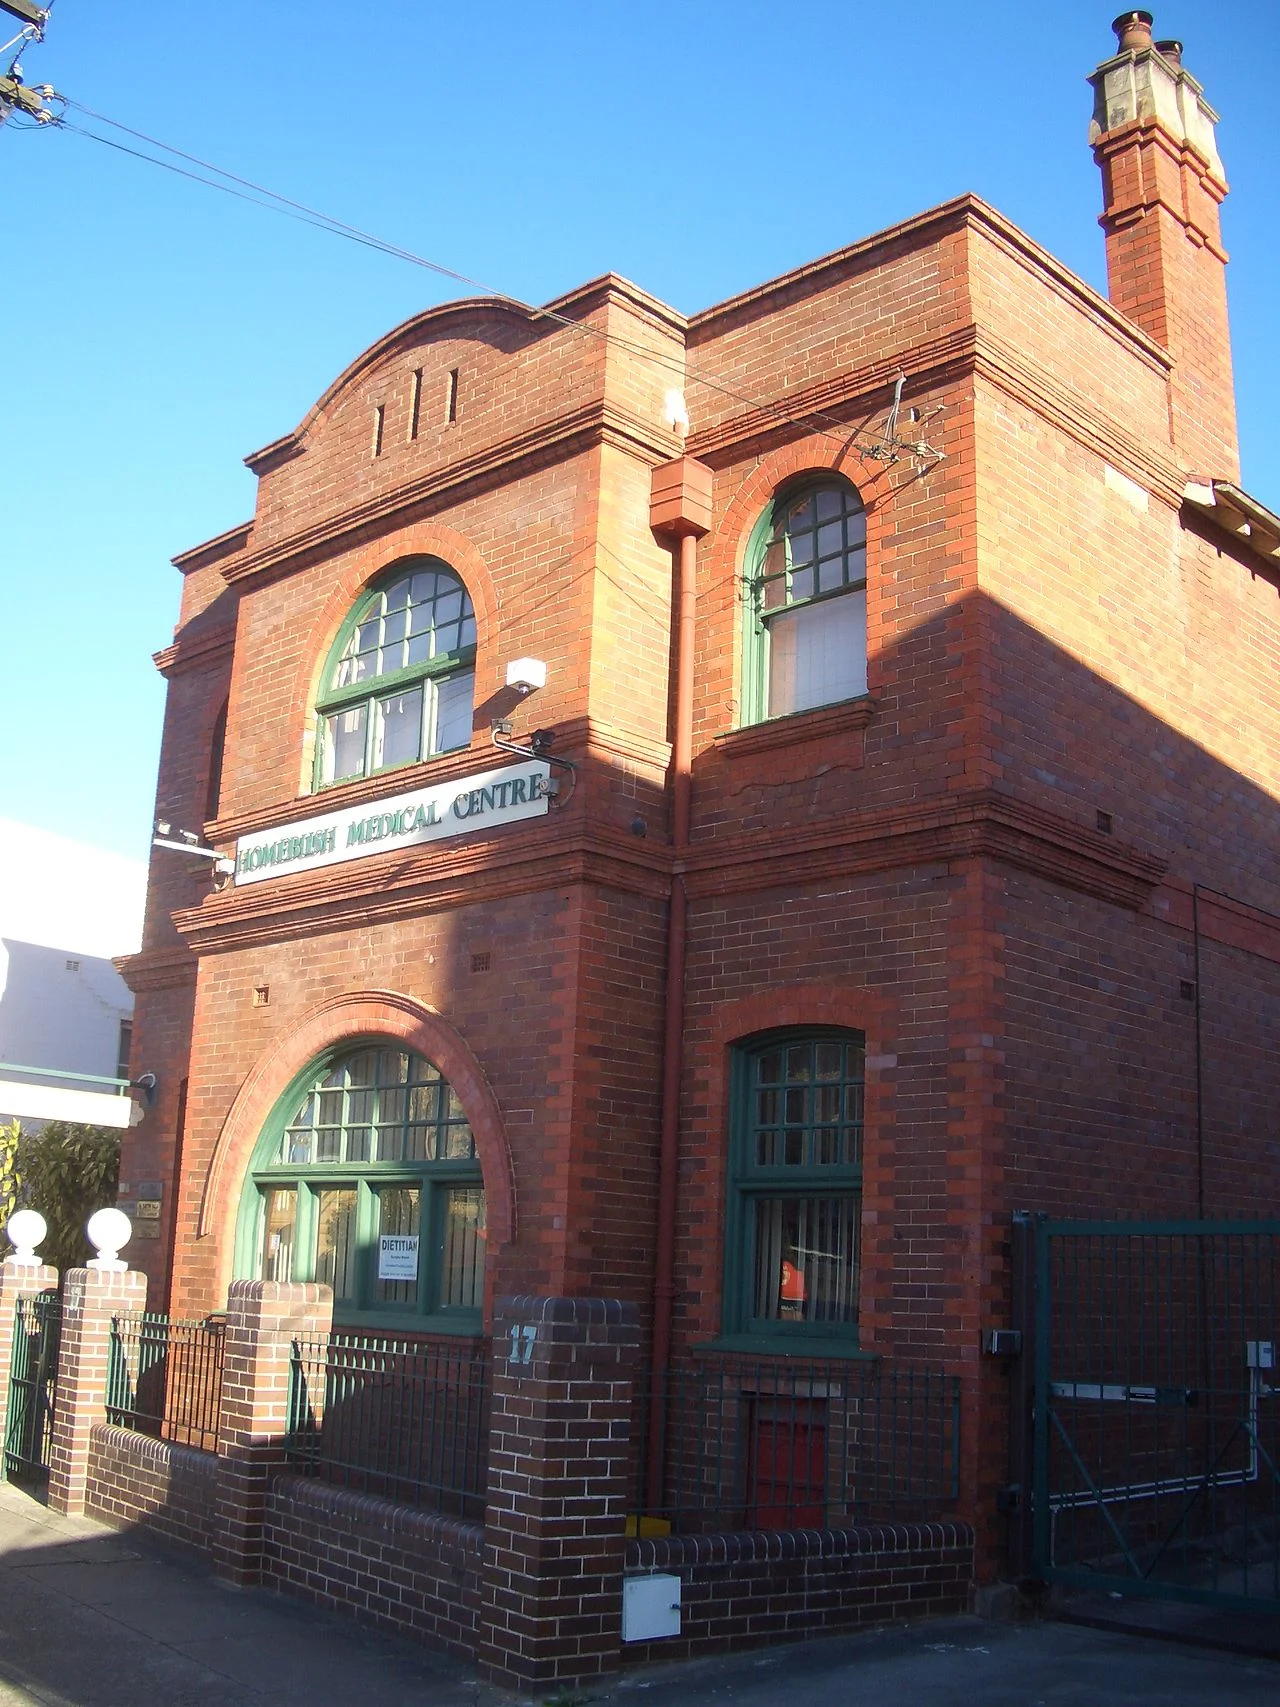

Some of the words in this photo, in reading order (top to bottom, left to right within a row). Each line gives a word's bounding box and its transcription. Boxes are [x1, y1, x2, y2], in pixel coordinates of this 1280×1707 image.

[236, 825, 338, 875] HOMEBUSH
[345, 799, 443, 848] MEDICAL
[453, 772, 543, 820] CENTRE
[382, 1239, 417, 1251] DIETITIAN
[510, 1324, 537, 1365] 17
